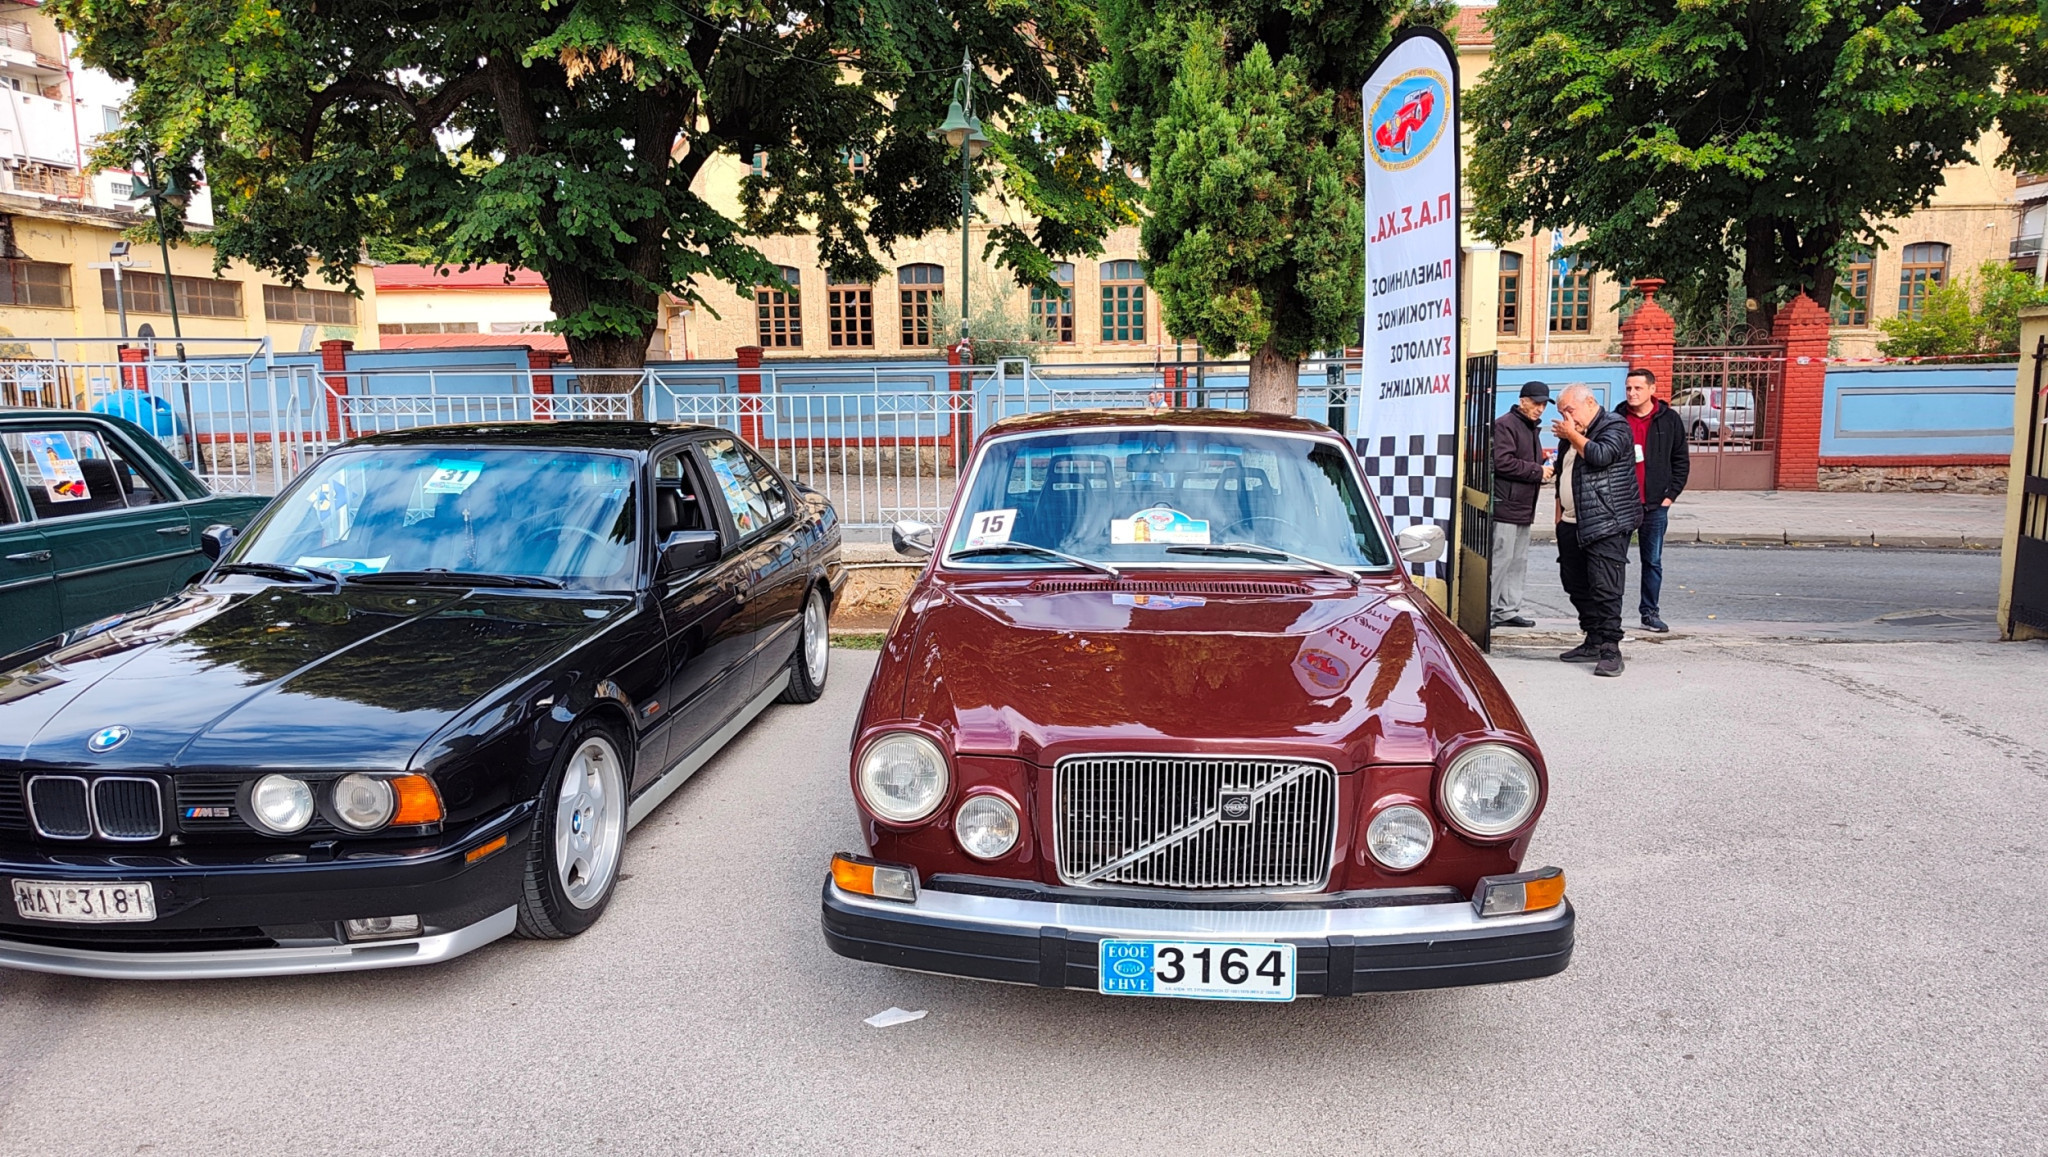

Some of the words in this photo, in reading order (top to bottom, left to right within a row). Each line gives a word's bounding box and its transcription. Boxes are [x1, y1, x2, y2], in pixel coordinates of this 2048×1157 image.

[439, 468, 471, 482] 31
[980, 515, 1005, 534] 15
[198, 807, 230, 817] M5
[1156, 946, 1286, 987] 3164
